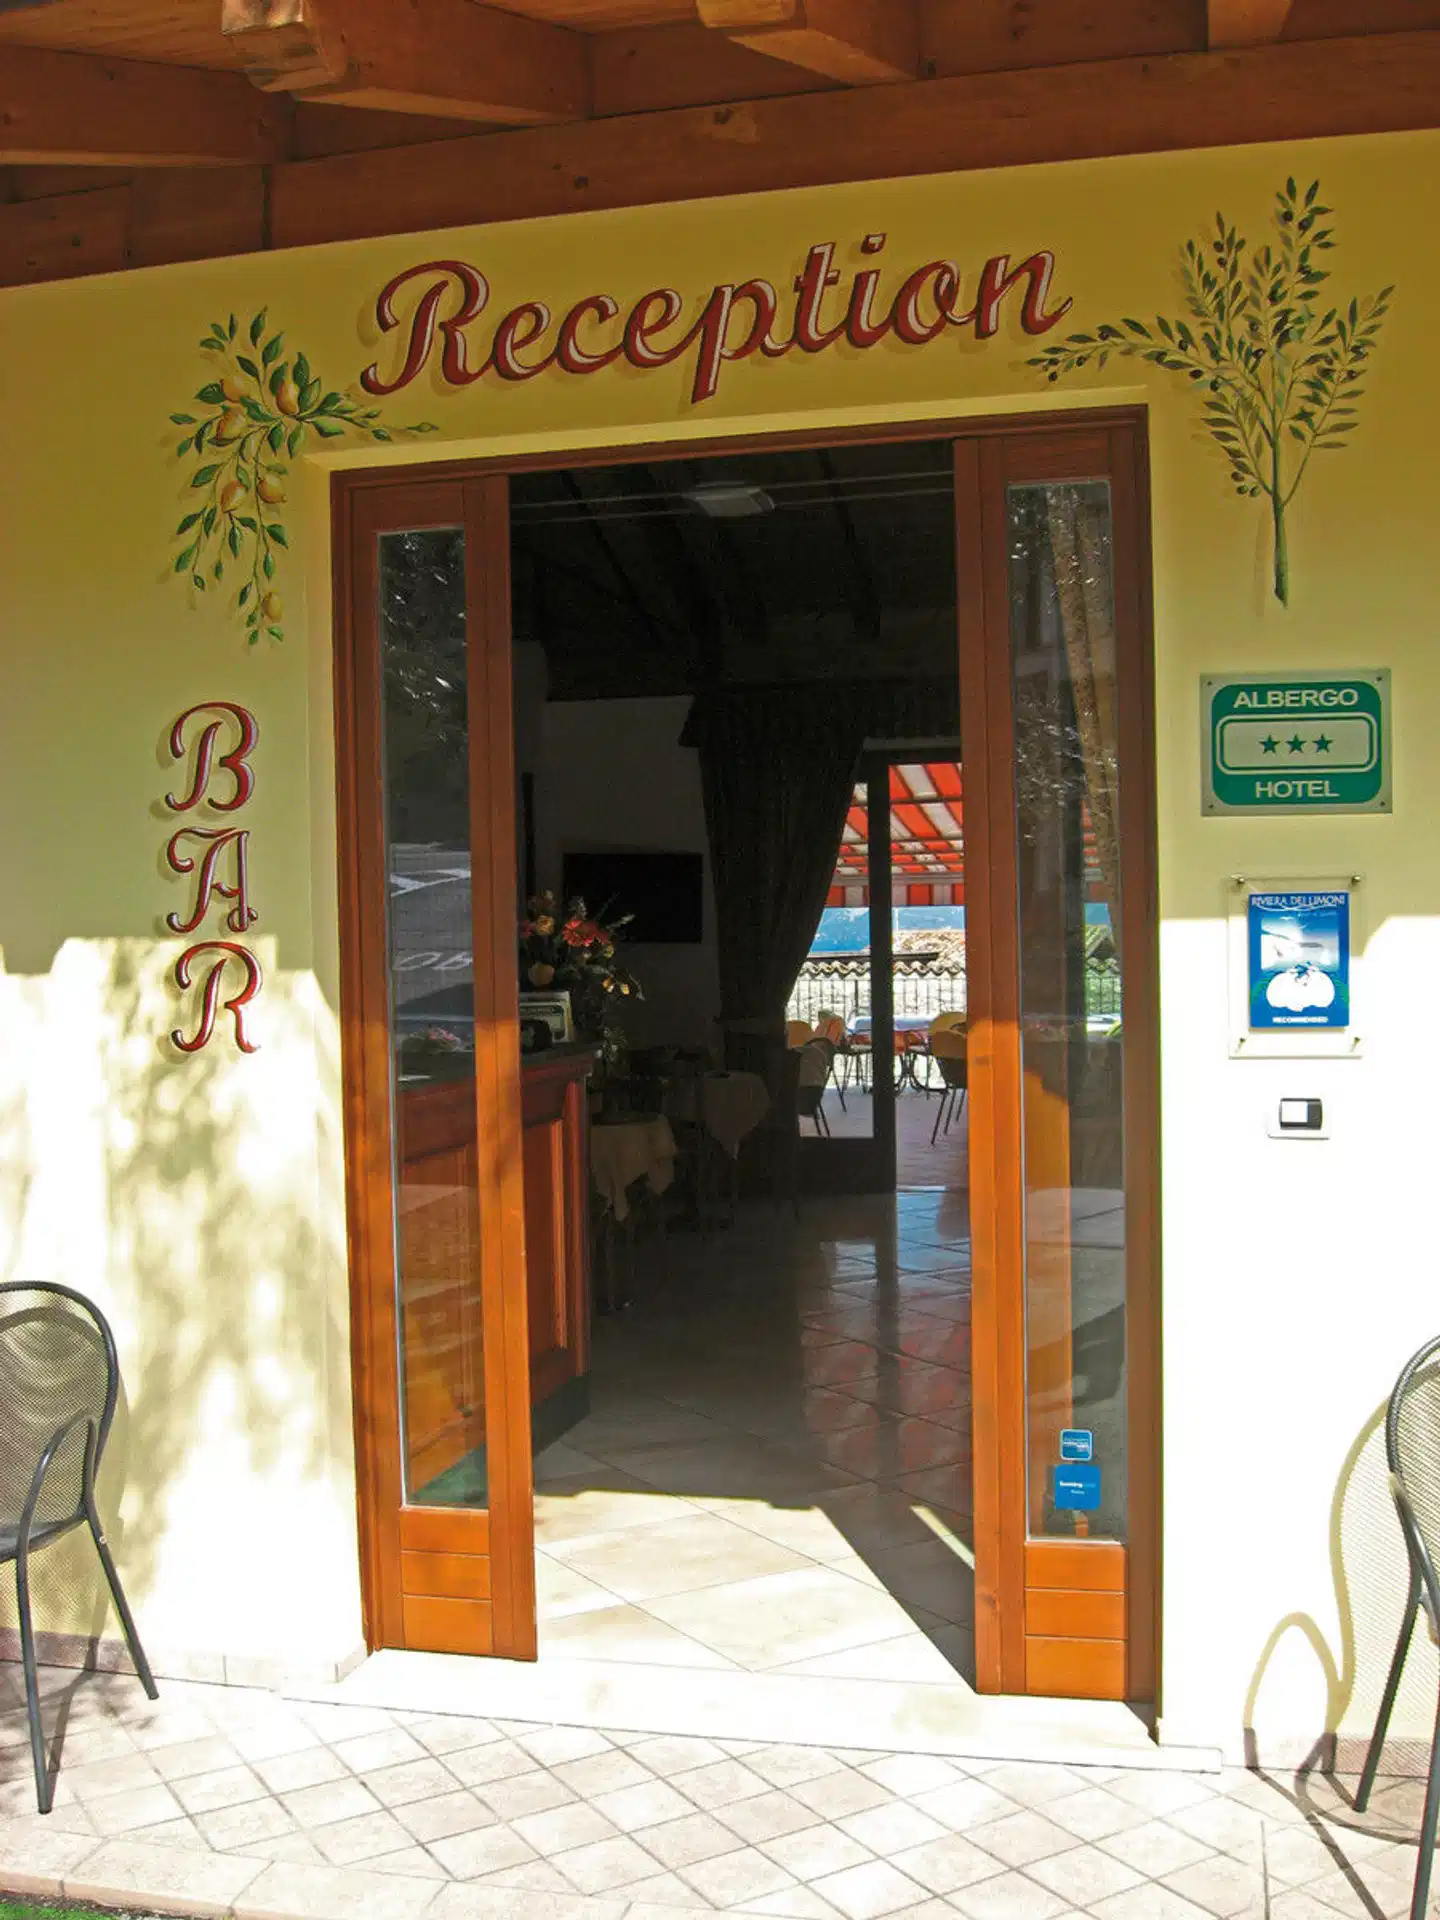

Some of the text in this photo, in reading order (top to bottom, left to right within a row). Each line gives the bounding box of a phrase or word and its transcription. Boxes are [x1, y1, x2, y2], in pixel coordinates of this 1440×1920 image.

[360, 232, 1073, 405] Reception
[1233, 688, 1359, 709] ALBERGO
[1255, 780, 1340, 799] HOTEL
[165, 701, 263, 1054] BAR
[1251, 896, 1288, 906] RIVIERA
